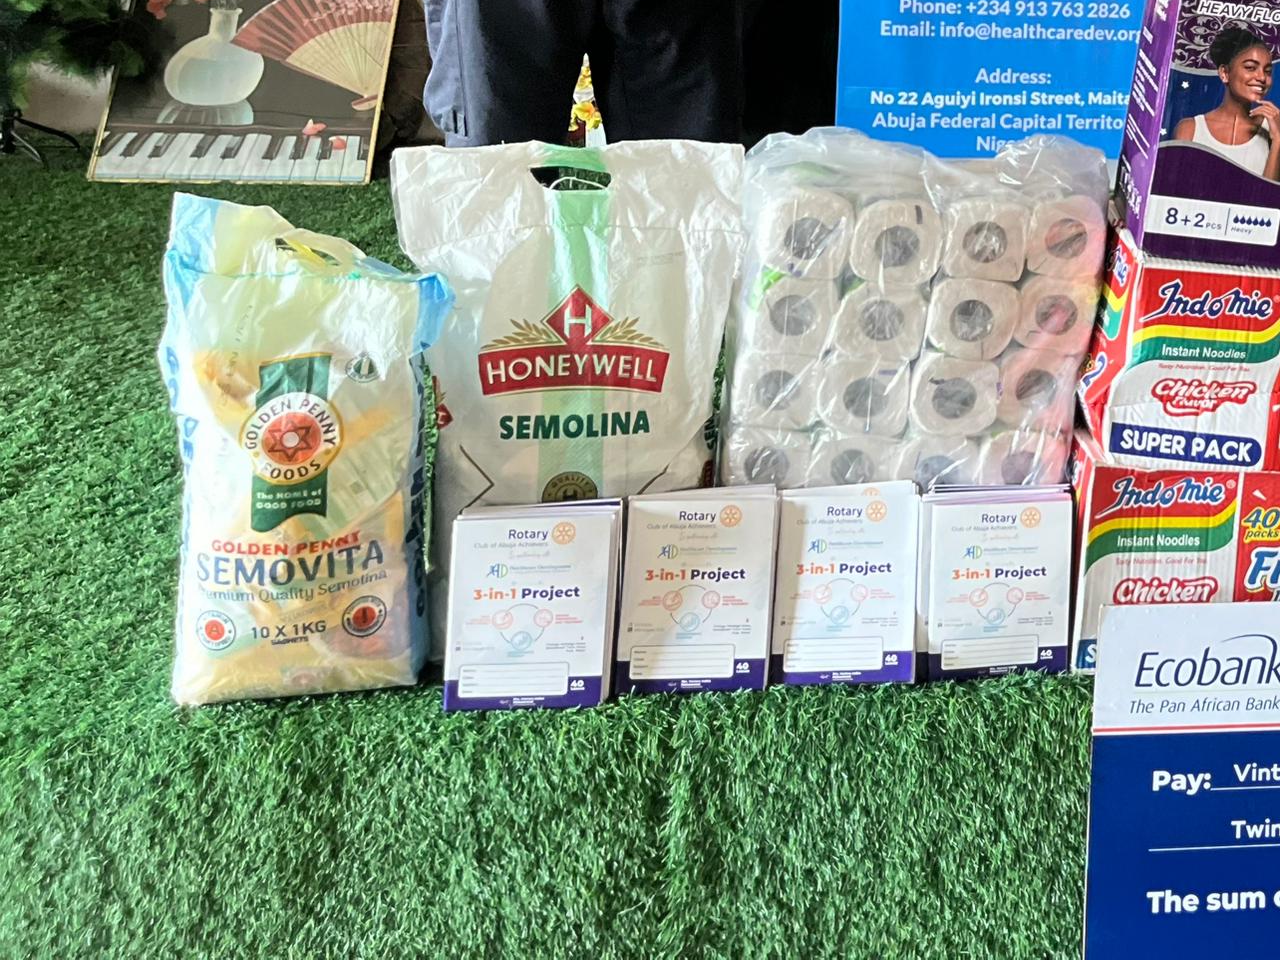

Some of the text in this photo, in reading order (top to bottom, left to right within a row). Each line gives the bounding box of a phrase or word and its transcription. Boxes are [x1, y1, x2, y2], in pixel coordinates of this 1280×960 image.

[966, 0, 1010, 16] +234
[1015, 1, 1047, 17] 913
[1051, 1, 1083, 18] 763
[1087, 2, 1130, 19] 2826
[1197, 0, 1251, 20] HEAVY
[881, 21, 935, 37] Email:
[873, 113, 1061, 132] Abuja Federal Capital
[487, 354, 657, 385] HONEYWELL
[500, 411, 650, 439] SEMOLINA
[826, 506, 863, 518] Rotary
[981, 513, 1017, 525] Rotary
[212, 531, 362, 555] GOLDEN PENNY
[508, 529, 548, 541] Rotary
[197, 540, 385, 588] SEMOVITA
[796, 562, 892, 576] 3-in-1 Project
[952, 566, 1047, 581] 3-in-1 Project
[473, 586, 580, 601] 3-in-1 Project
[252, 621, 327, 639] 10 X 1KG
[1130, 696, 1280, 714] The Pan African Bank
[1152, 770, 1212, 796] Pay:
[1147, 890, 1199, 913] The
[1206, 890, 1266, 911] sum
